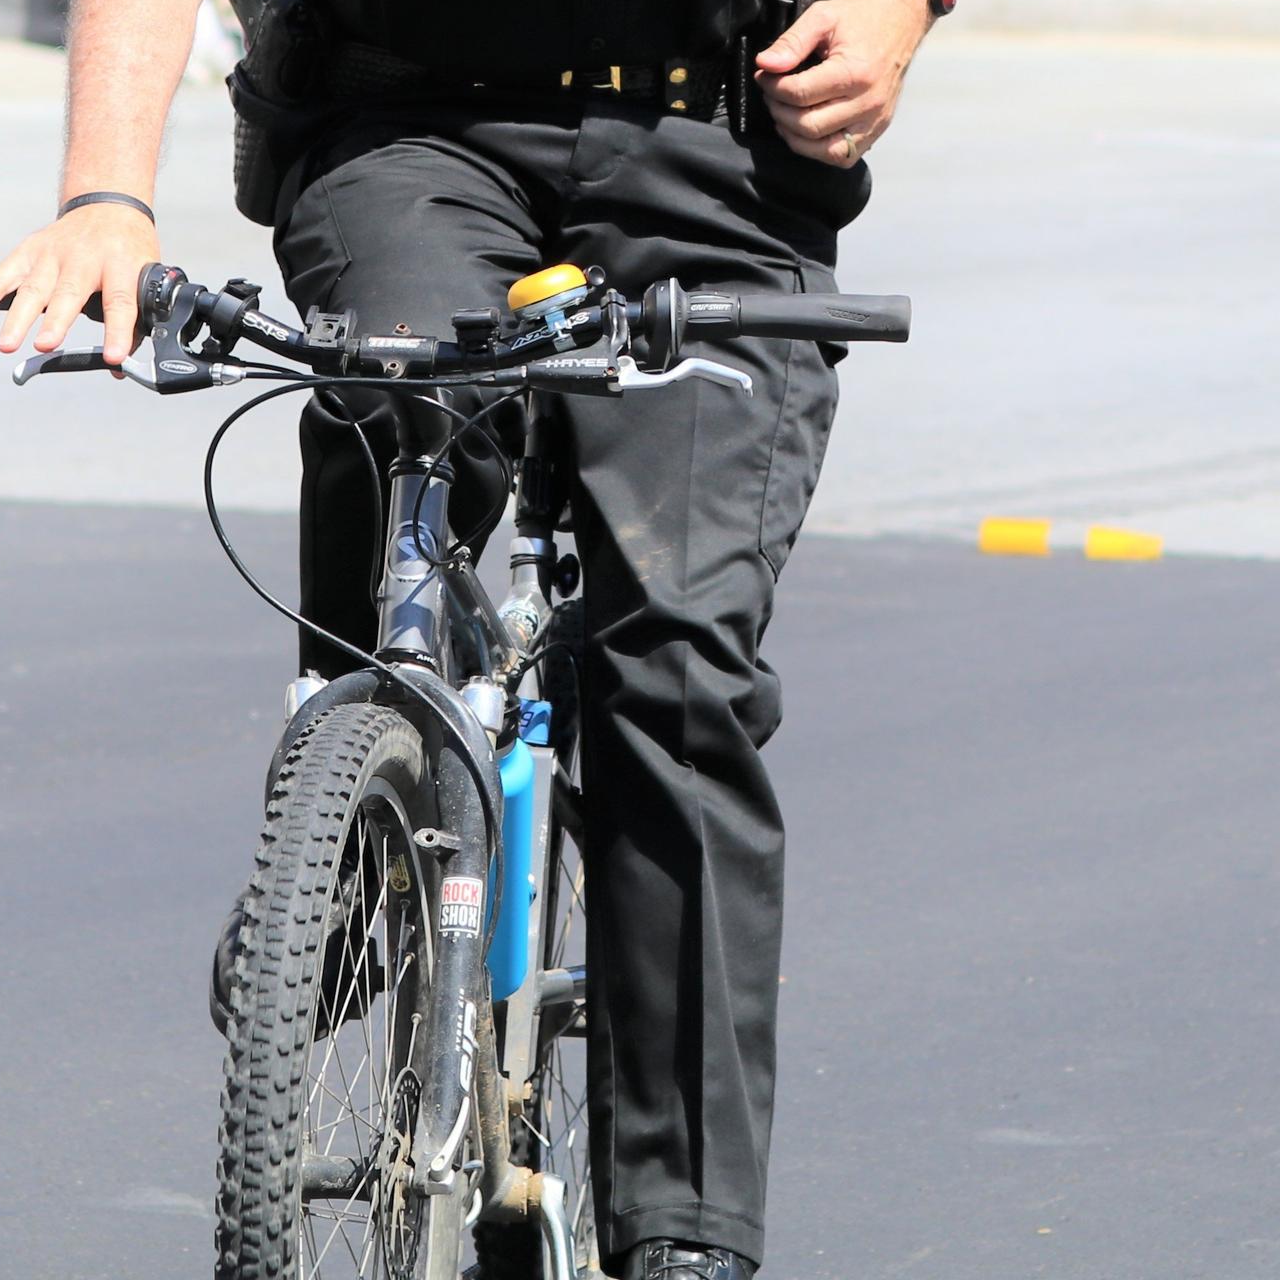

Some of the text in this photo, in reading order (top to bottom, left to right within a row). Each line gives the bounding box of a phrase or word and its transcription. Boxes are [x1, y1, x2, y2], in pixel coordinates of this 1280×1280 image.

[544, 357, 608, 368] HAYES
[443, 882, 479, 904] ROCK
[441, 904, 478, 928] SHOX
